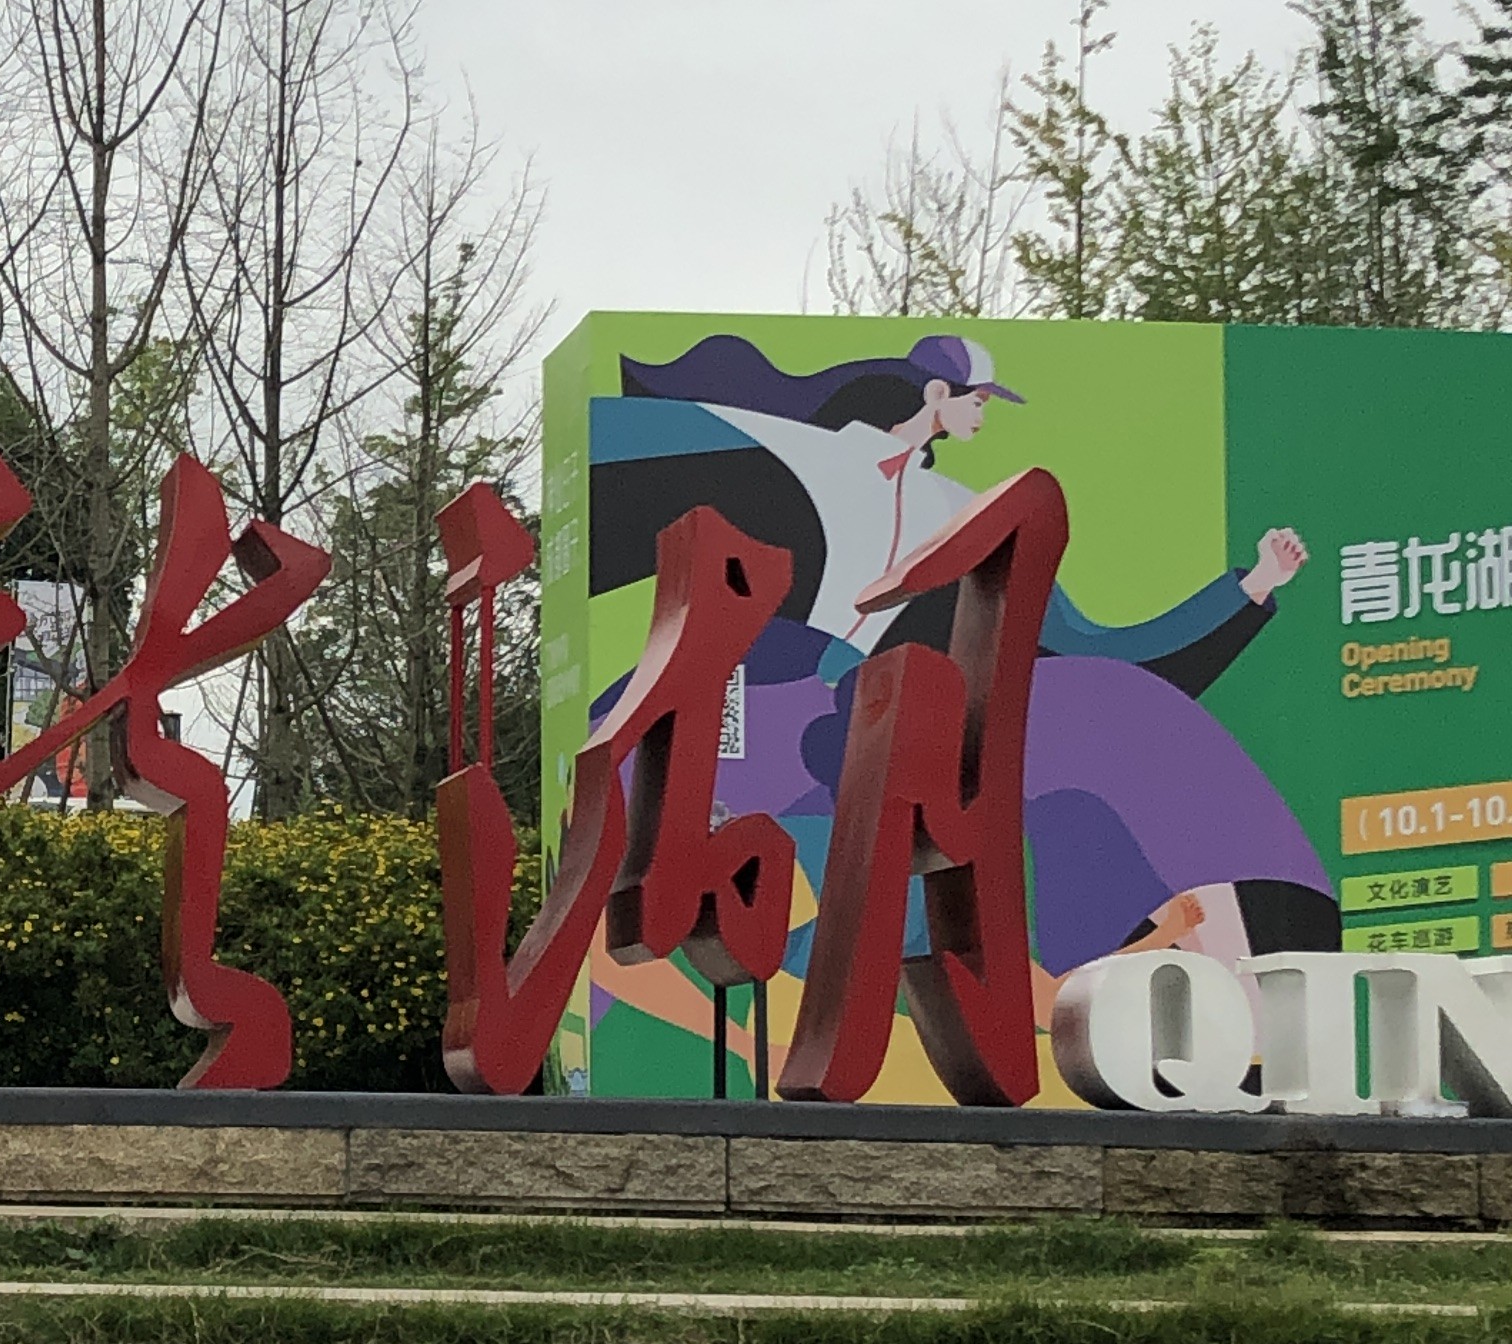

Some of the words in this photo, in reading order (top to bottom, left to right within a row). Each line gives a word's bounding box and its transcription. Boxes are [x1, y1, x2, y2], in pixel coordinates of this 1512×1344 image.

[1340, 525, 1512, 625] 青龙湖
[1341, 635, 1452, 671] Opening
[1341, 664, 1480, 698] Ceremony
[1366, 874, 1454, 903] 文化演艺
[1367, 926, 1454, 953] 花车巡游
